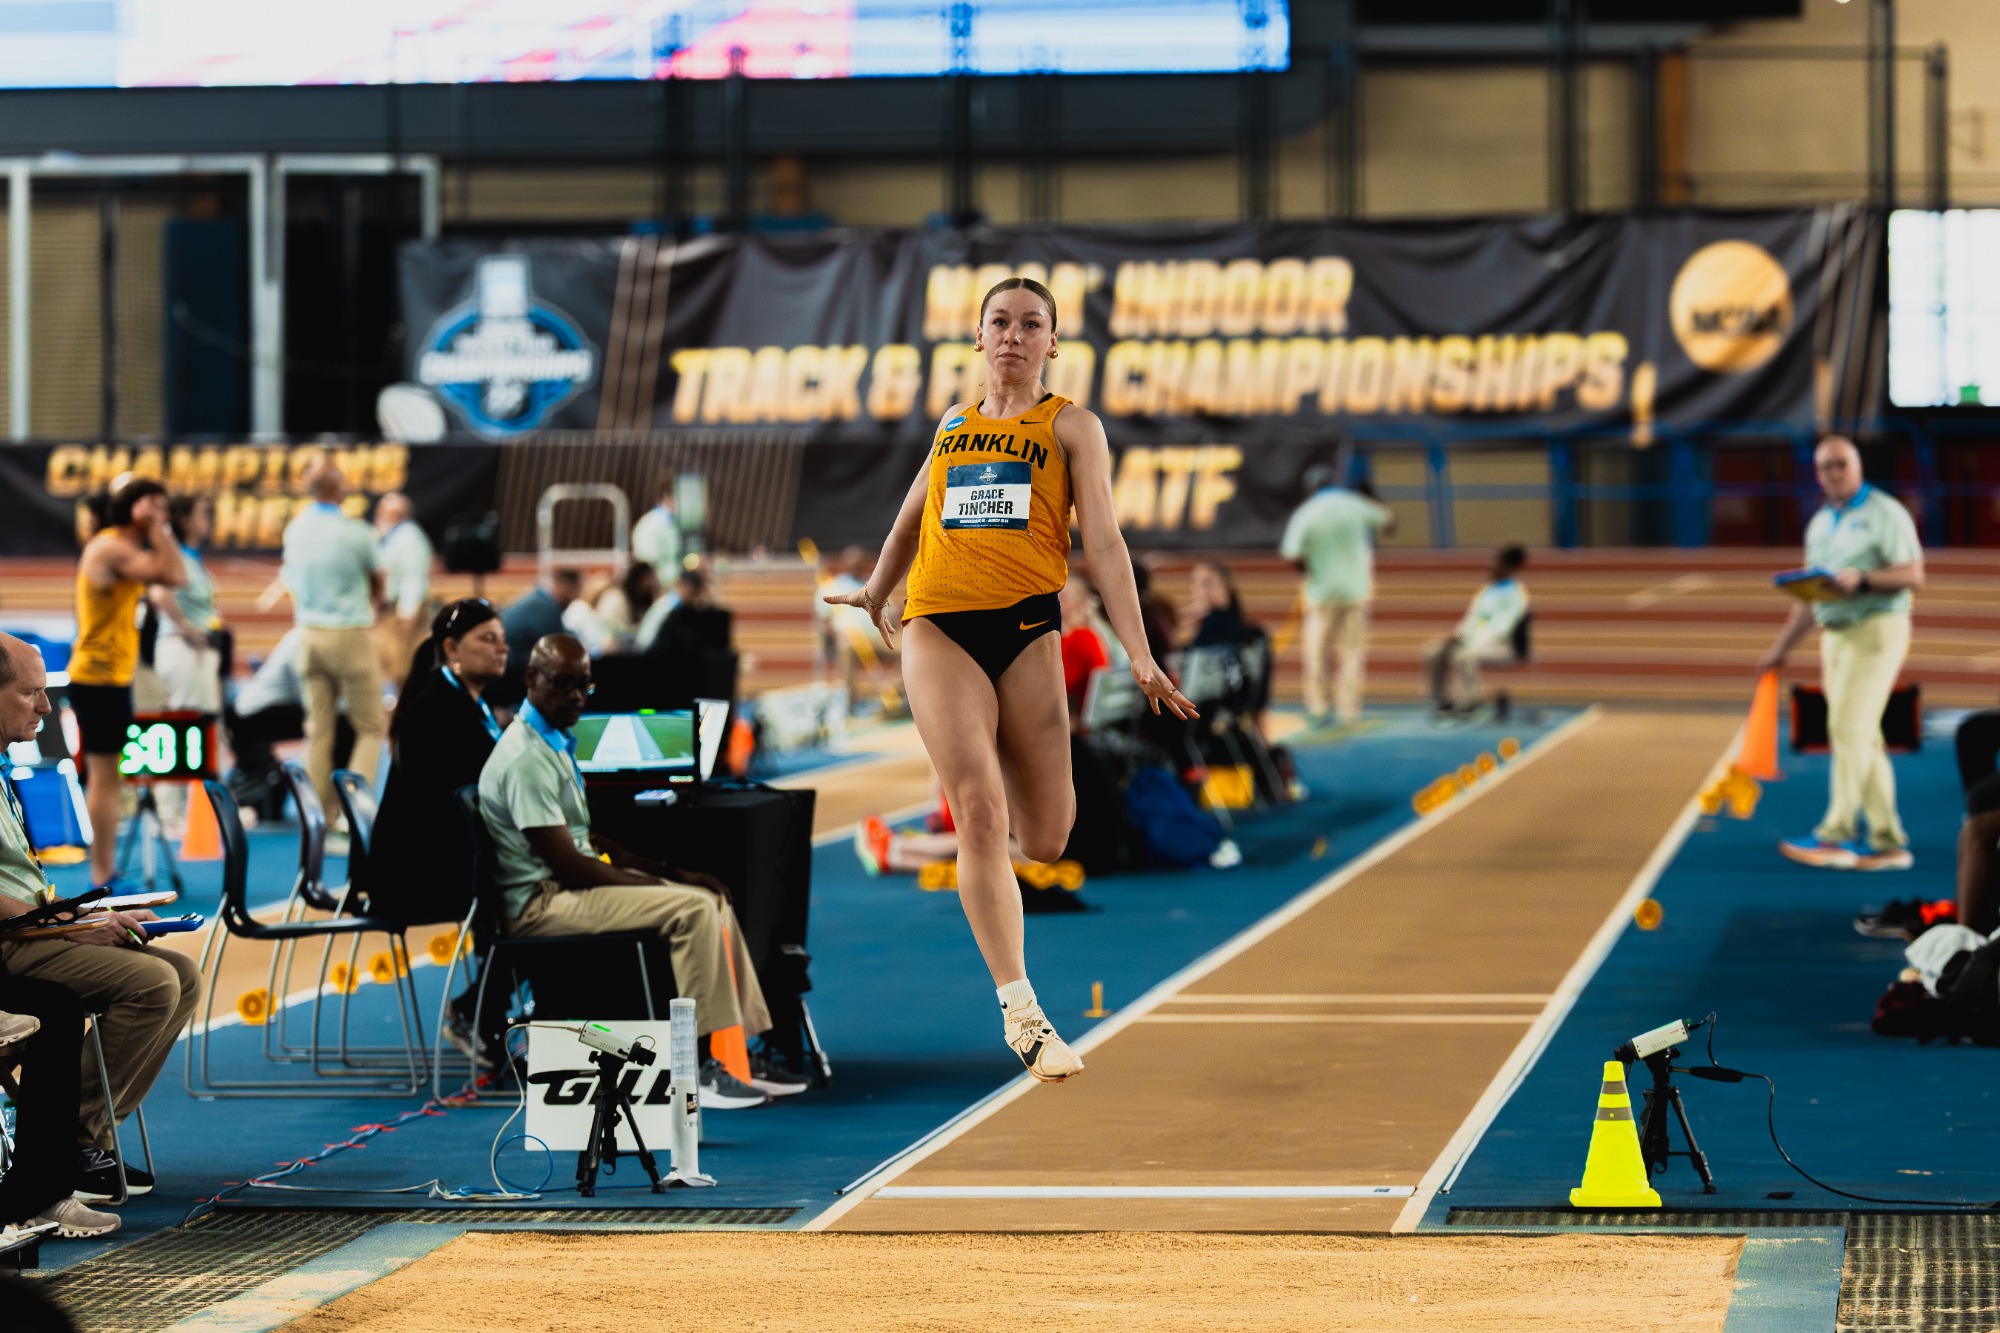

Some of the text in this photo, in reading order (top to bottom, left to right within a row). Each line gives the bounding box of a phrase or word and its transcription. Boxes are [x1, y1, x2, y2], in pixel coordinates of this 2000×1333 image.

[1108, 257, 1354, 337] INDOOR
[671, 345, 868, 424] TRACK
[1102, 331, 1629, 418] CHAMPIONSHIPS
[970, 488, 1005, 501] GRACE
[958, 501, 1014, 516] TINCHER
[1020, 1019, 1044, 1032] NIKE
[543, 1069, 671, 1105] GLL
